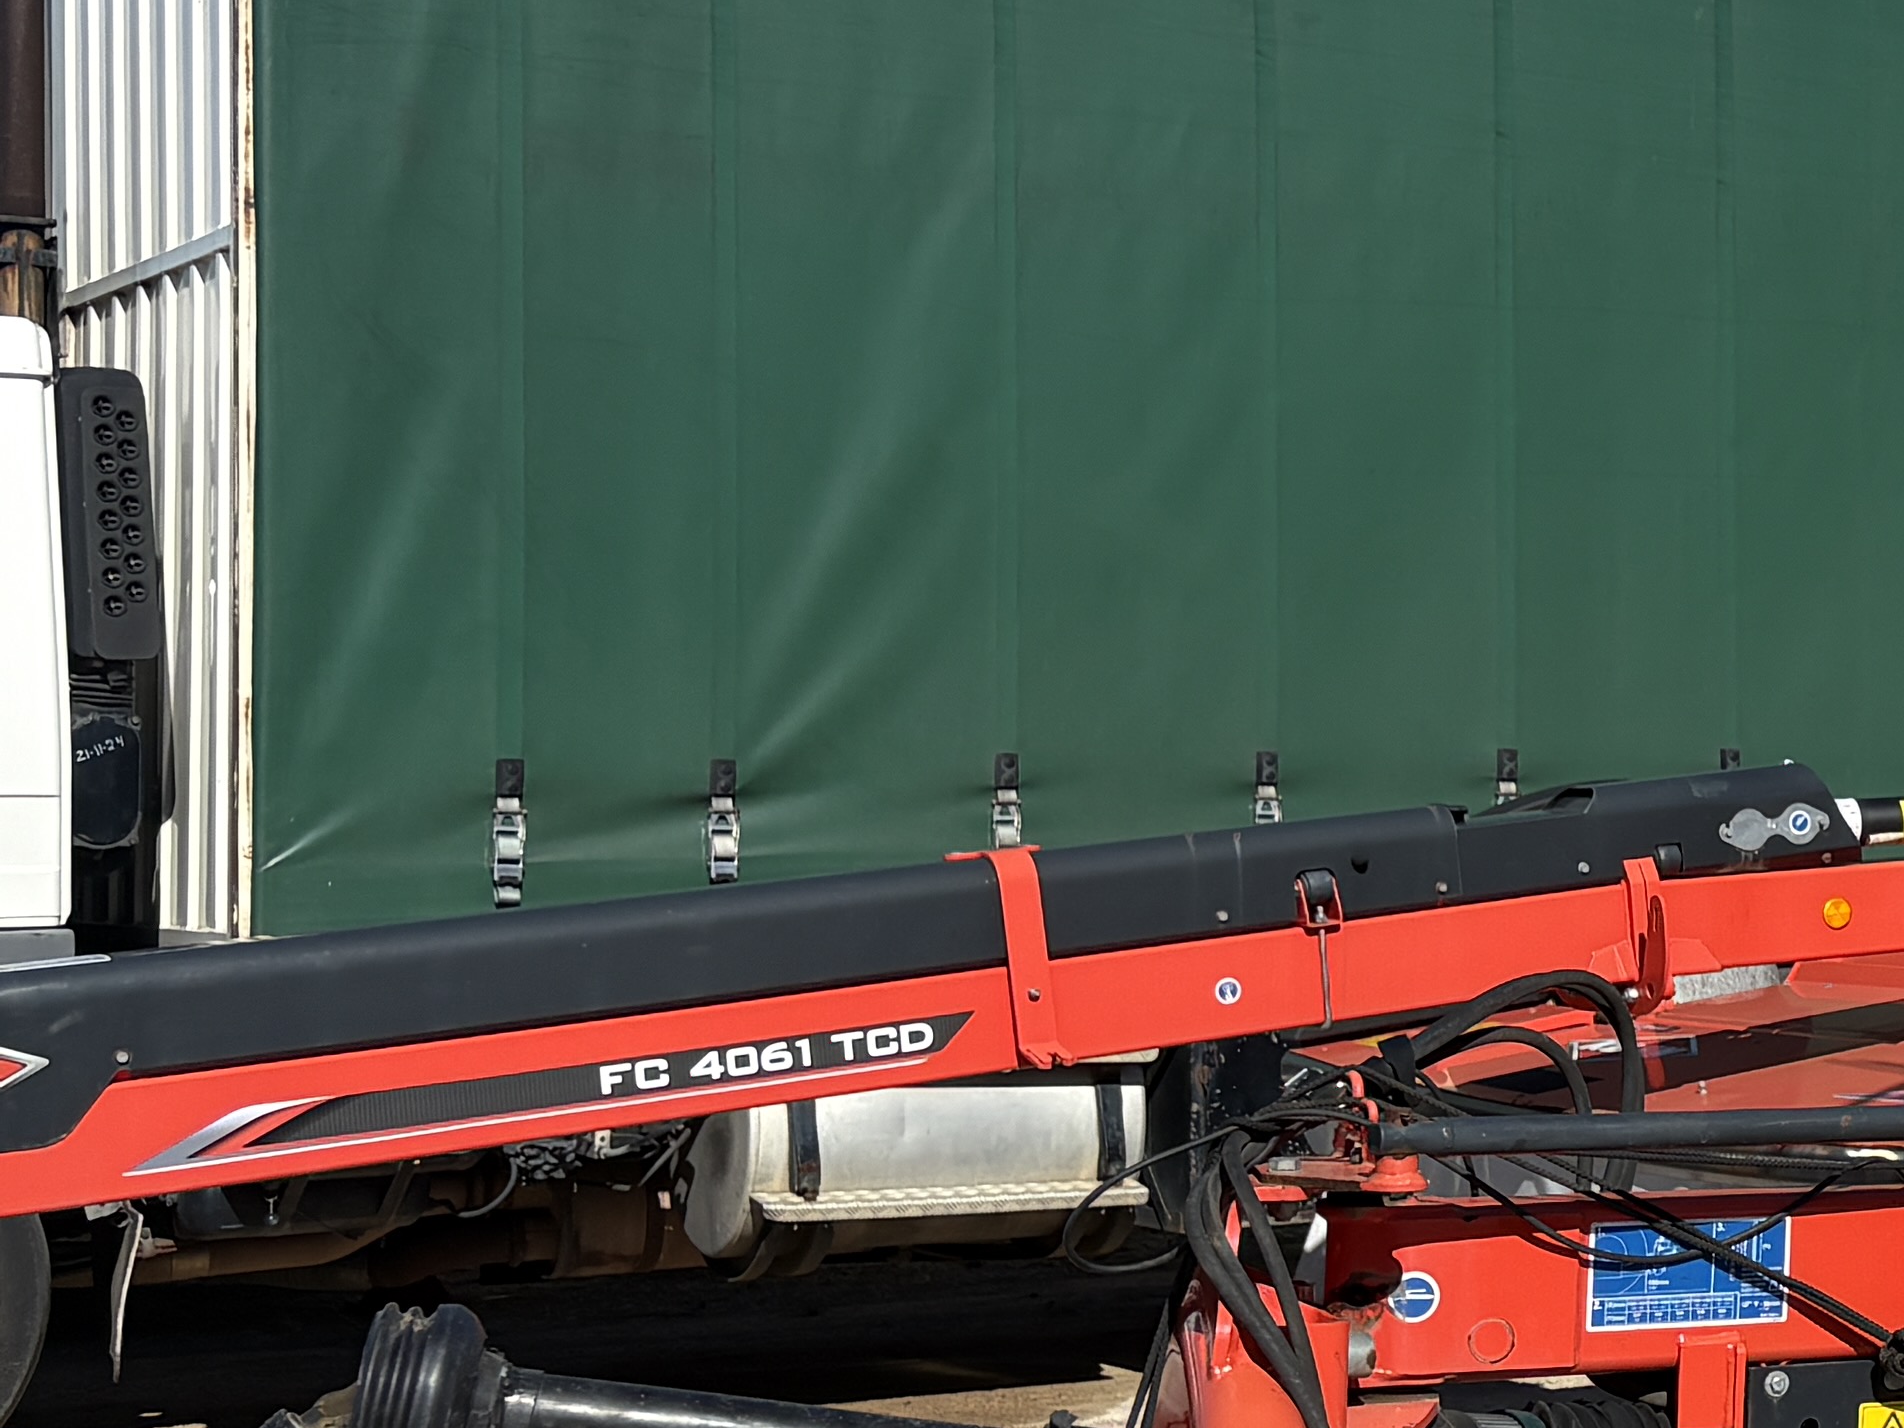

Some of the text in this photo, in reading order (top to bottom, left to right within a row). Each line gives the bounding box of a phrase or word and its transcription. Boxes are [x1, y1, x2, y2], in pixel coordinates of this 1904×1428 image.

[599, 1022, 935, 1096] FC 4061 TCD
